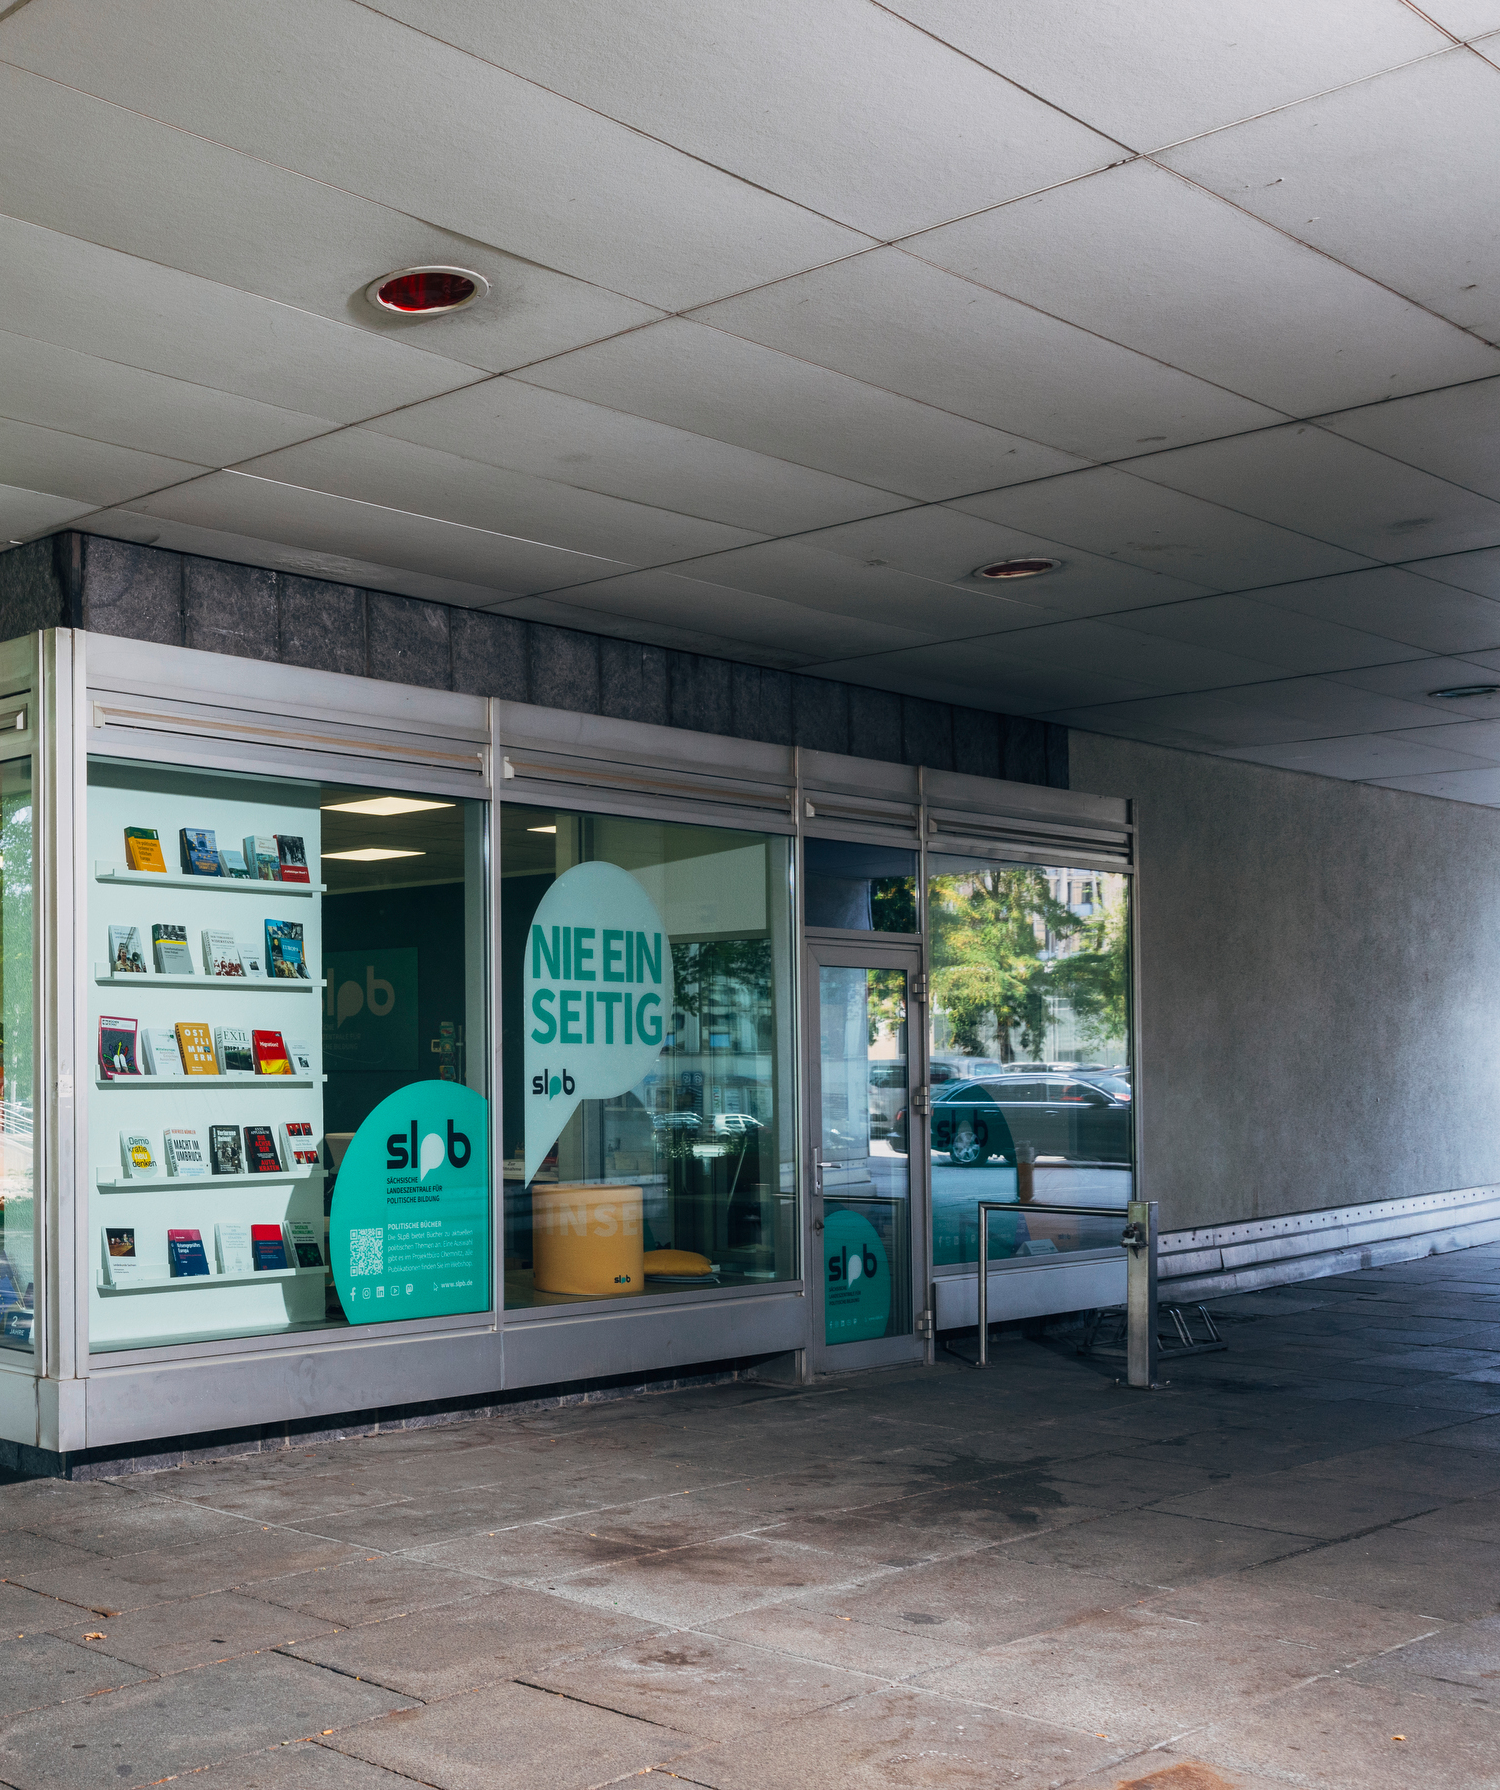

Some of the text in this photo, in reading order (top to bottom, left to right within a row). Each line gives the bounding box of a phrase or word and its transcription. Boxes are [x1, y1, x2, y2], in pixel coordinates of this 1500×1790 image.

[532, 924, 662, 984] NIE EIN
[531, 988, 662, 1046] SEITIG
[223, 1031, 249, 1041] EXIL
[194, 1037, 209, 1045] FLI
[187, 1045, 204, 1053] MM
[128, 1137, 149, 1145] Demo
[173, 1139, 200, 1150] MACHT IM
[127, 1145, 147, 1153] kratie
[176, 1151, 202, 1161] UMBRUCH
[132, 1159, 157, 1168] denken
[387, 1176, 418, 1184] SÄCHSISCHE
[387, 1184, 443, 1194] LANDESZENTRALE FÜR
[387, 1195, 440, 1204] POLITISCHE BILDUNG
[388, 1220, 442, 1230] POLITISCHE BÜCHER
[427, 1230, 443, 1238] Bücher
[388, 1244, 414, 1252] politischen
[454, 1238, 473, 1246] Auswahl
[388, 1255, 397, 1263] gibt
[412, 1251, 440, 1260] Projektbüro
[388, 1265, 420, 1273] Publikationen
[441, 1279, 473, 1288] www.slpb.de
[11, 1315, 18, 1327] 2
